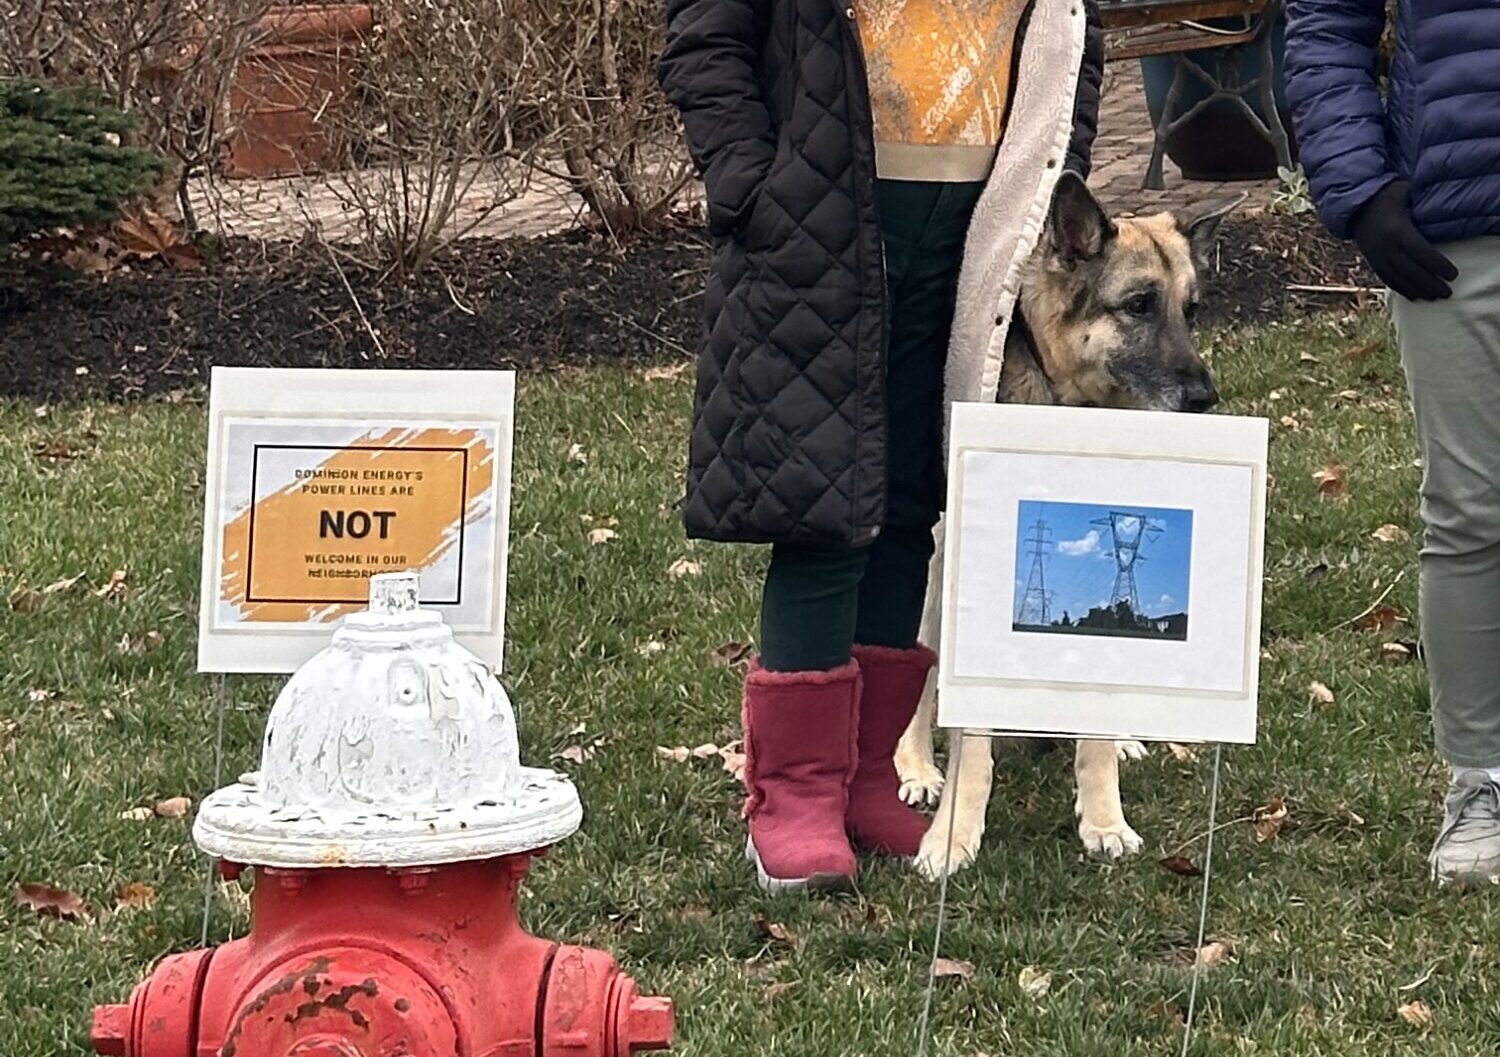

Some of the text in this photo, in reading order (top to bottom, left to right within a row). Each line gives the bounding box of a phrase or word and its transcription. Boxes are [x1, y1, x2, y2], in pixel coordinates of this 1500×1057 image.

[295, 469, 423, 481] DOMINION ENERGY'S
[302, 484, 415, 496] POWER LINES ARE
[320, 510, 397, 539] NOT
[304, 554, 407, 565] WELCOME IN OUR
